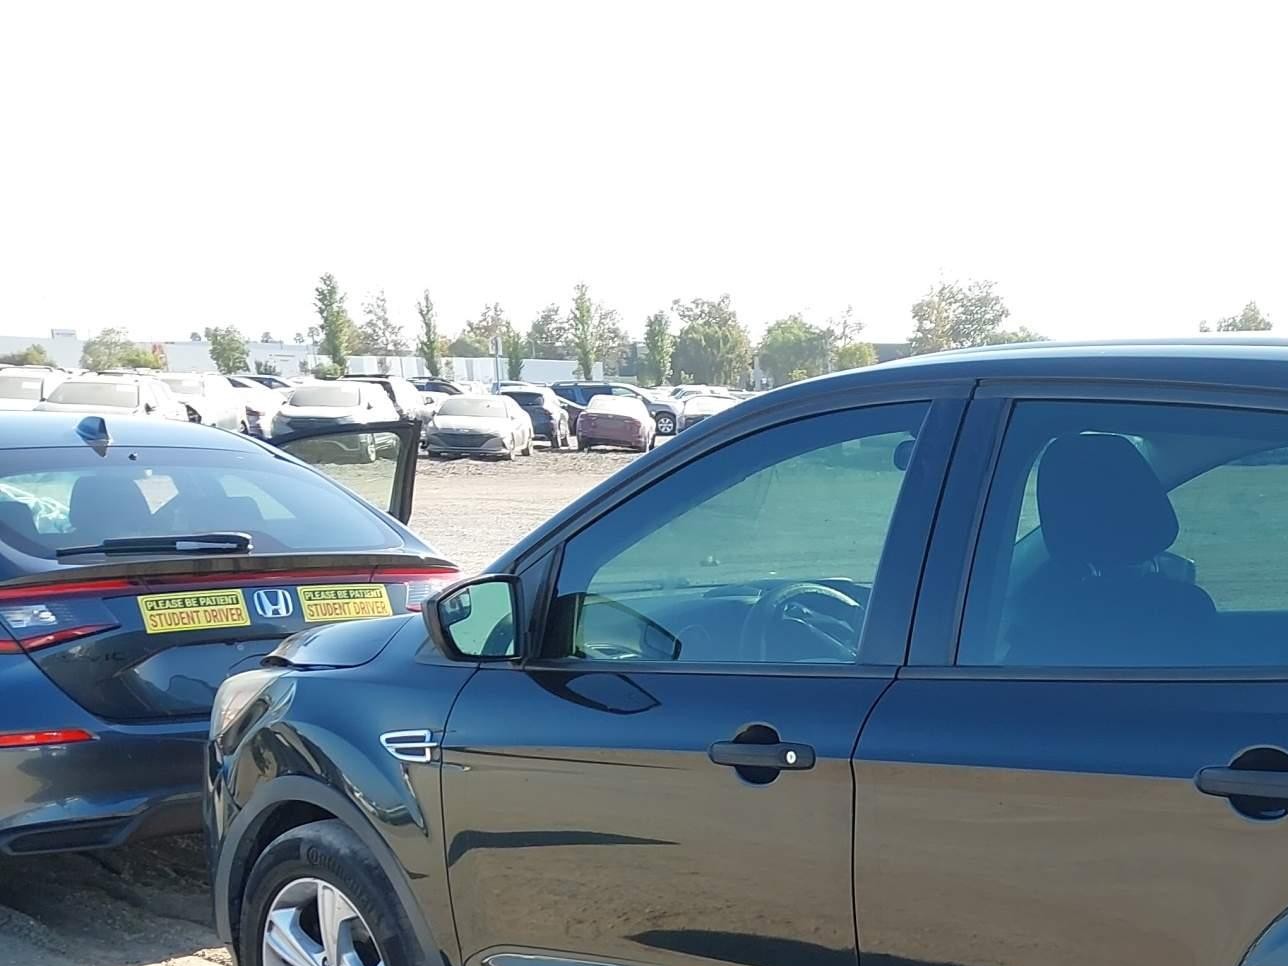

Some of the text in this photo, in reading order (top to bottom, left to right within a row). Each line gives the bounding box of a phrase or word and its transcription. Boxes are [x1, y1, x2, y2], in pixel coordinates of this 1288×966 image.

[304, 589, 382, 600] PLEASE BE PATIENT
[146, 595, 238, 611] PLEASE BE PATIENT
[307, 600, 388, 617] STUDENT DRIVER
[149, 607, 245, 628] STUDENT DRIVER
